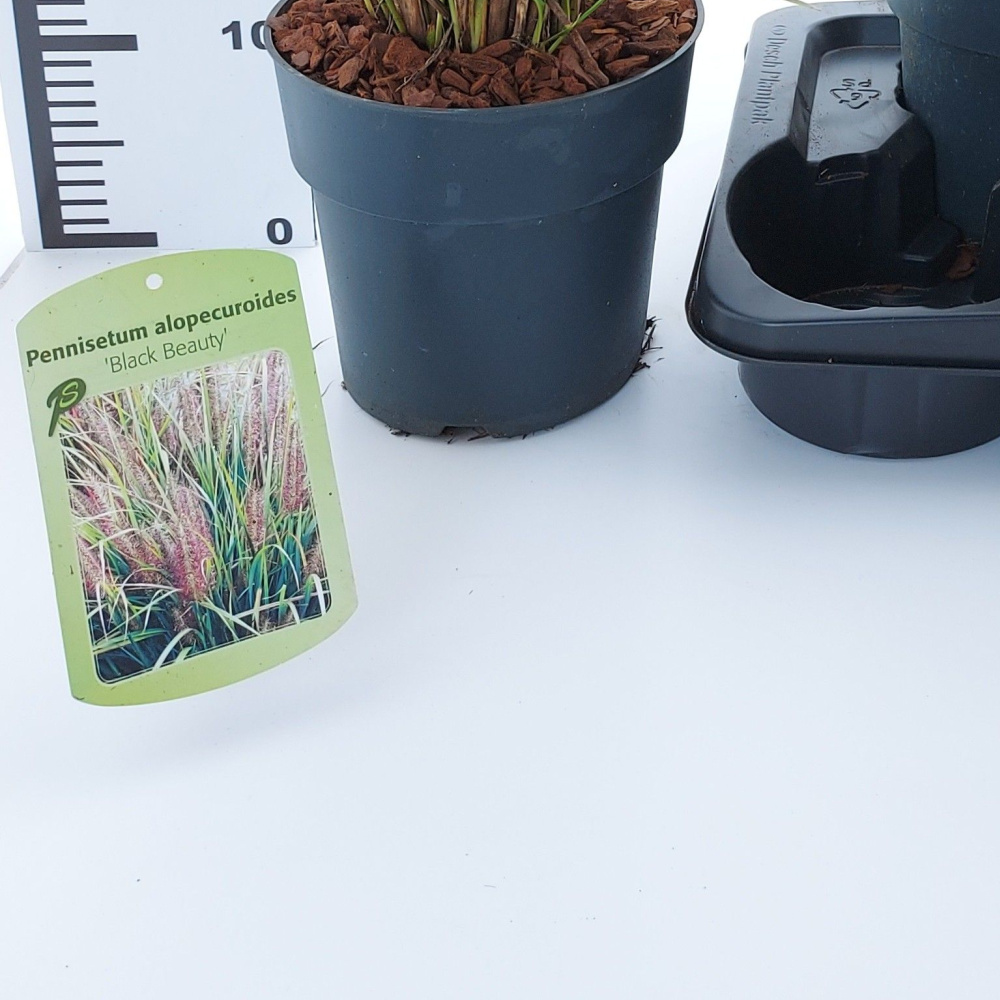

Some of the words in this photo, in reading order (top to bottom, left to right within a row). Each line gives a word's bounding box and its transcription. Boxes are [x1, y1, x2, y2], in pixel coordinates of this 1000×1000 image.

[266, 217, 293, 246] 0
[26, 324, 149, 368] Pennisetum
[155, 286, 298, 336] alopecuroides
[104, 347, 159, 375] 'Black
[163, 328, 229, 361] Beauty'
